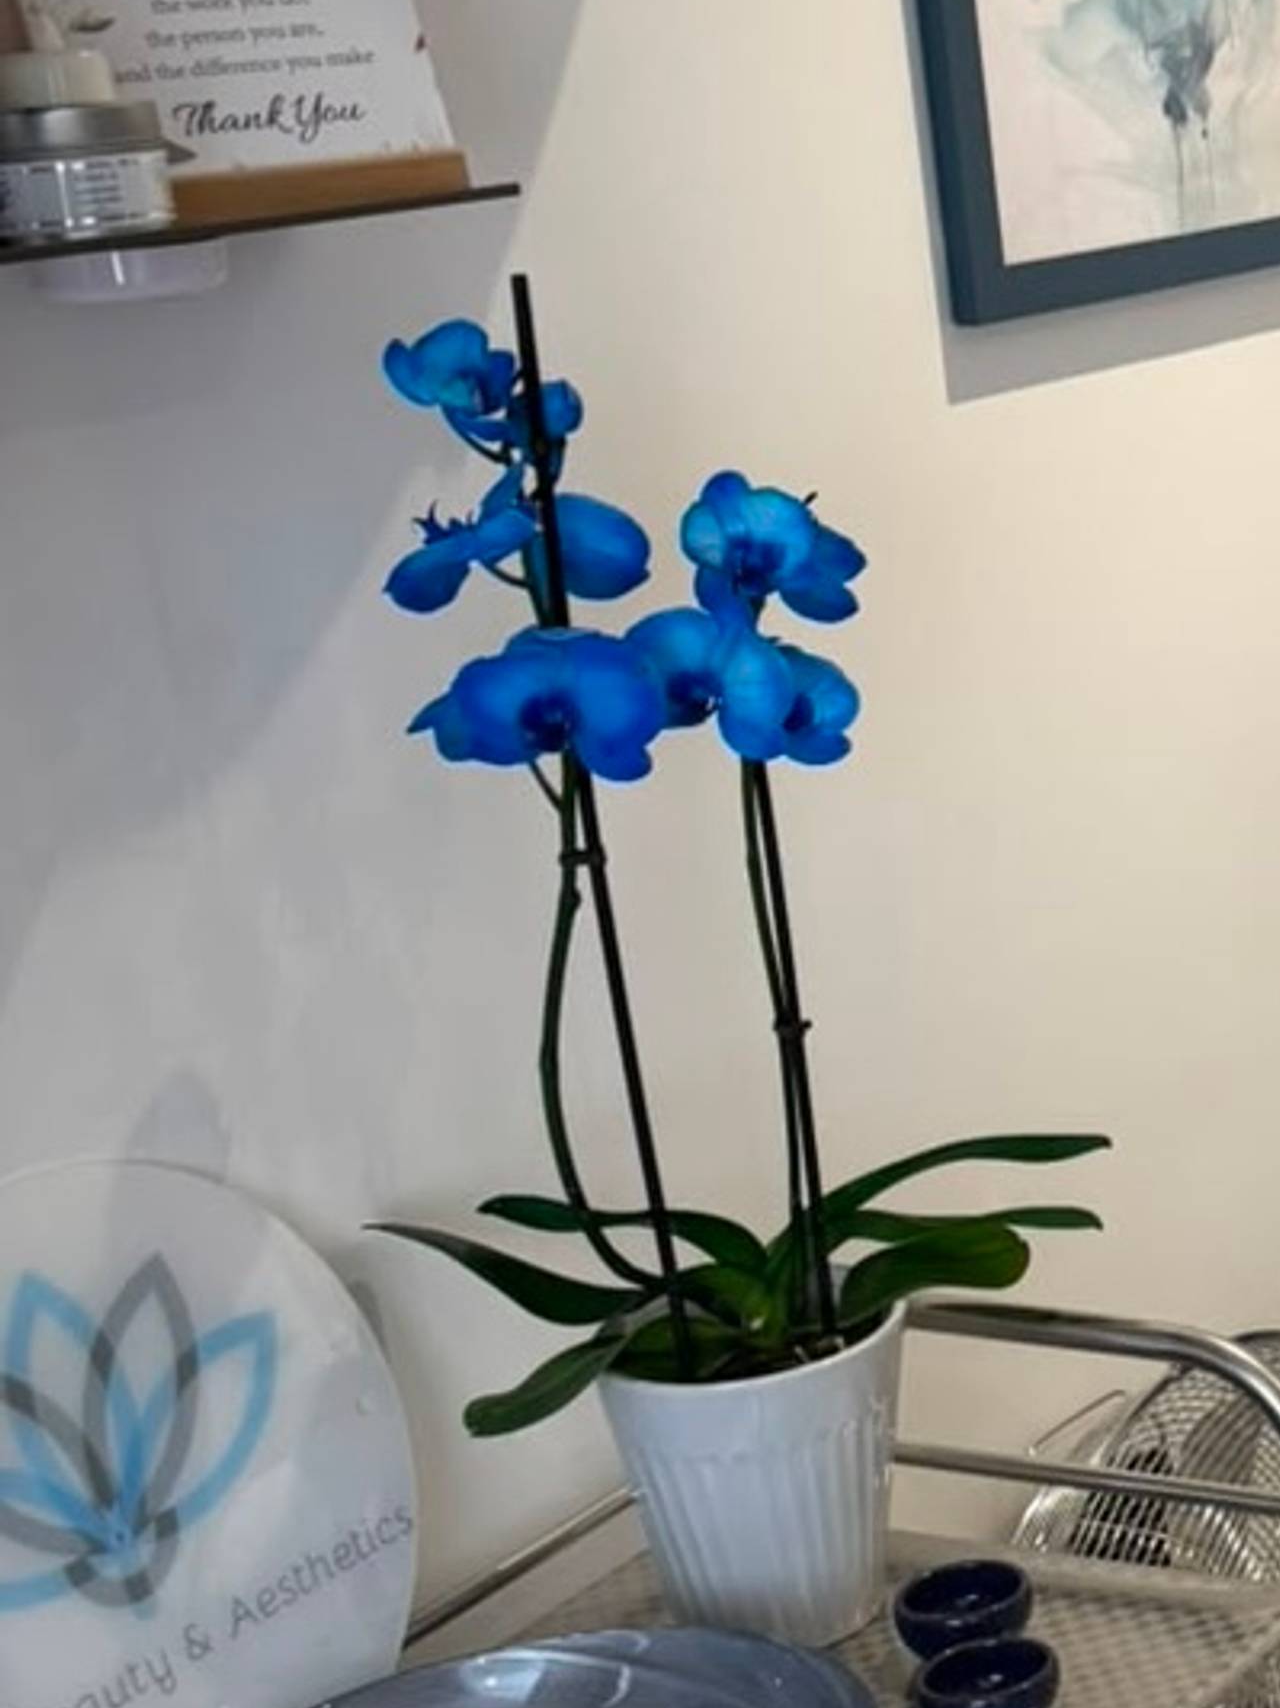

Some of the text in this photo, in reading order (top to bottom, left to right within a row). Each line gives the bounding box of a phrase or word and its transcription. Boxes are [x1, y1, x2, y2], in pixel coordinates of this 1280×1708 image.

[146, 29, 178, 48] the
[181, 26, 245, 50] person
[249, 26, 285, 45] you
[155, 59, 185, 79] the
[189, 56, 281, 79] difference
[286, 55, 322, 76] you
[171, 90, 366, 144] Thank You
[182, 1621, 214, 1661] &
[229, 1504, 414, 1641] Aesthetics
